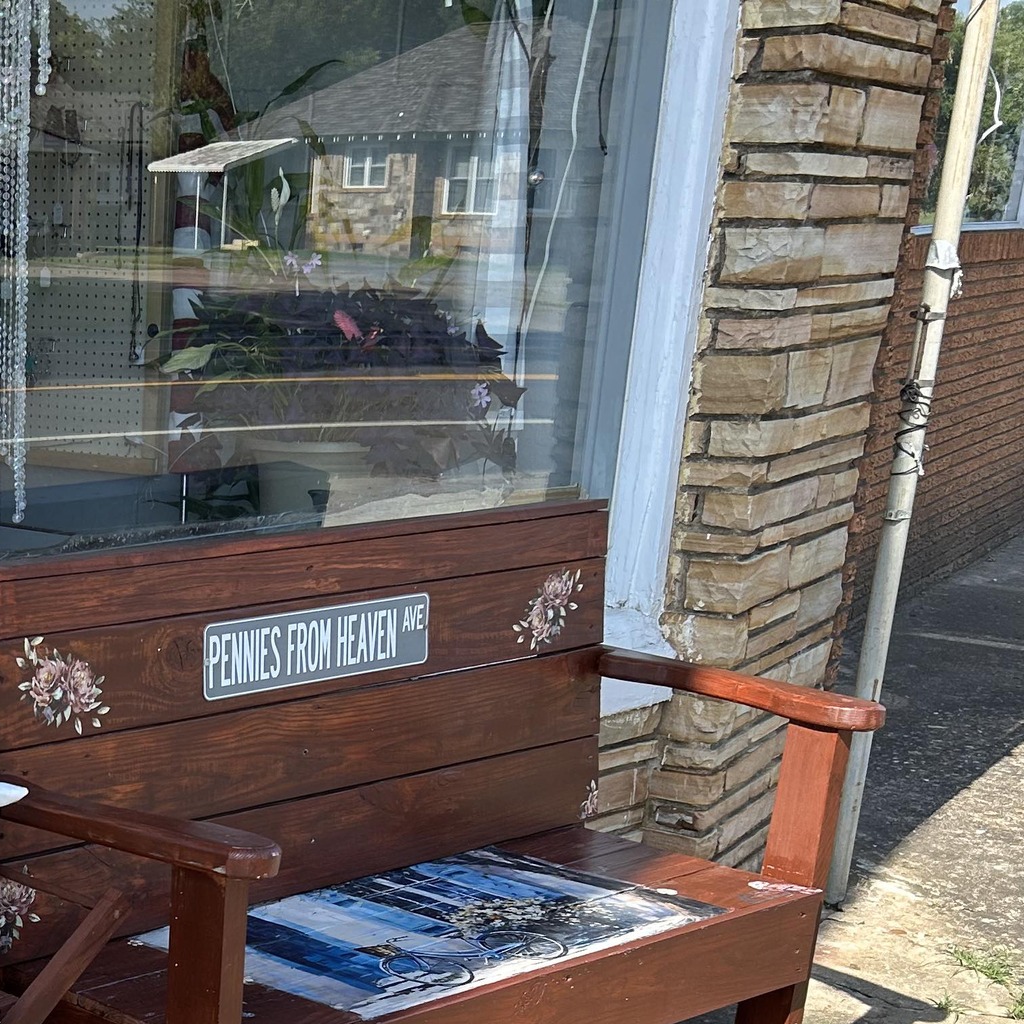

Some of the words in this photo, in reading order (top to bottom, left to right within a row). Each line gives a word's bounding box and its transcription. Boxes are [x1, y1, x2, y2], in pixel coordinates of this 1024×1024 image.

[209, 625, 281, 689] PENNIES
[287, 617, 332, 676] FROM
[336, 608, 397, 667] HEAVEN
[402, 604, 425, 632] AVE
